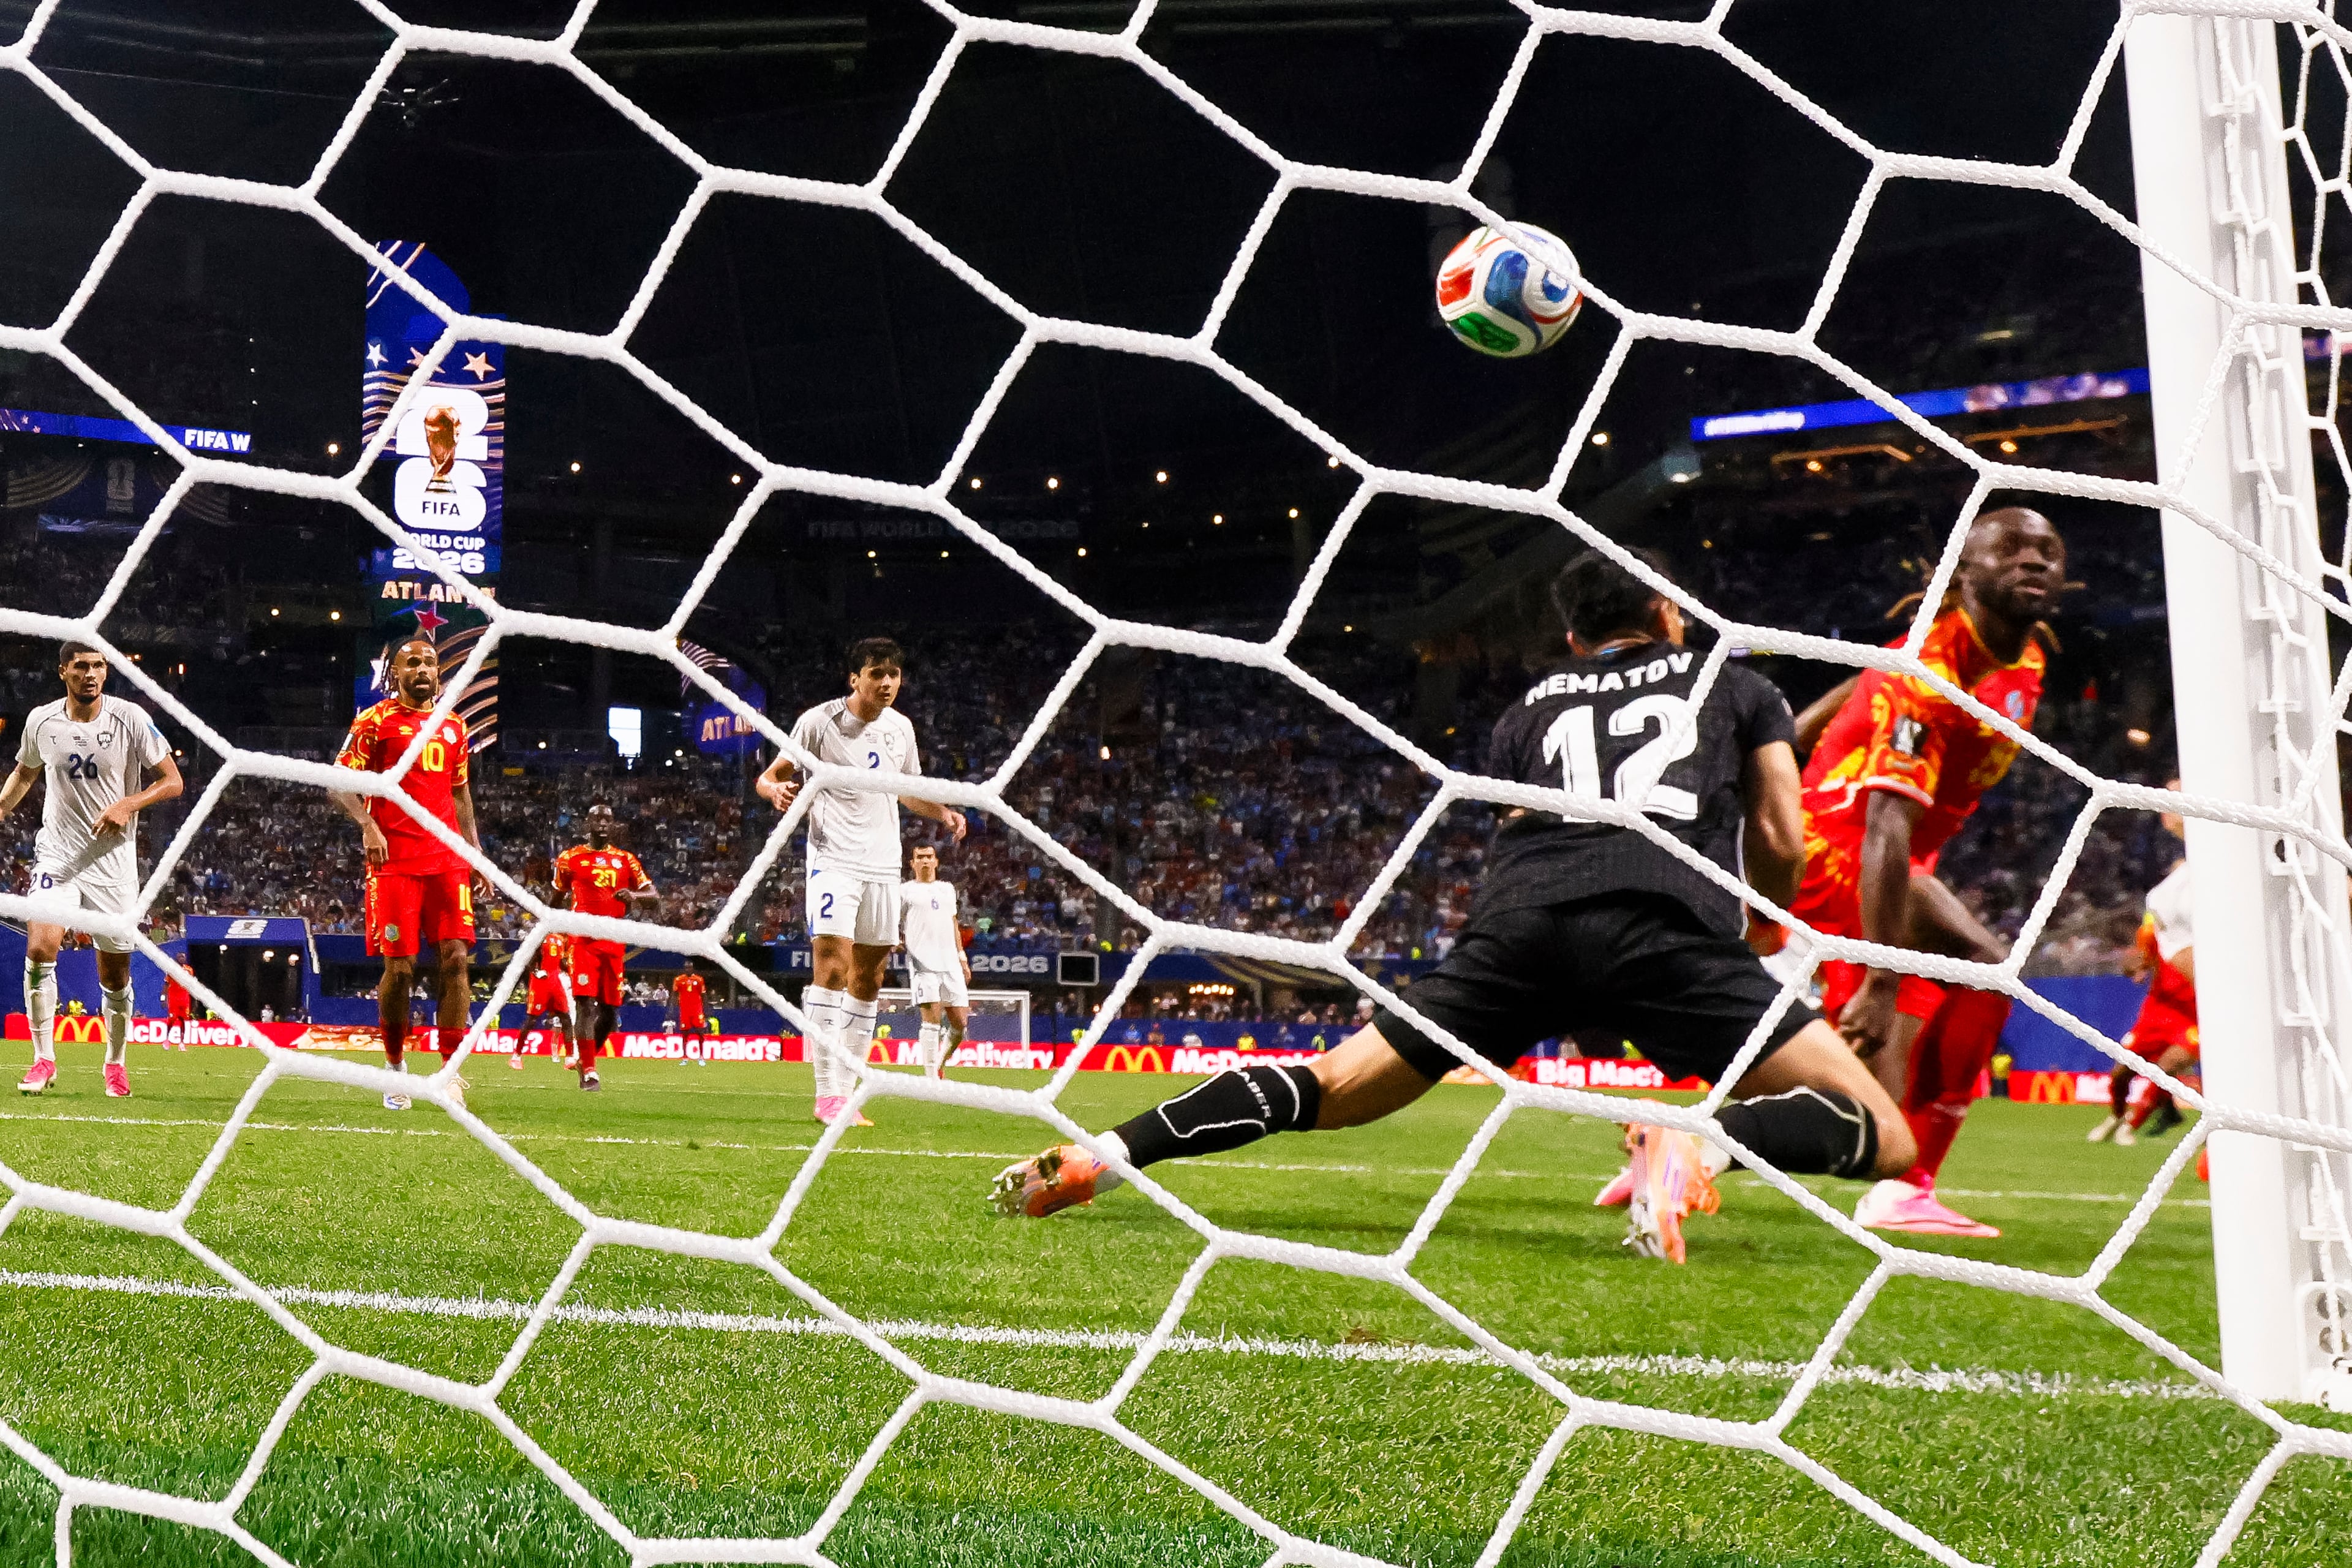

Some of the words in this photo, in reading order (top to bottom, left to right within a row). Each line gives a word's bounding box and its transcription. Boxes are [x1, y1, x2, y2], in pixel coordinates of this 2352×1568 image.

[185, 429, 230, 450] FIFA
[231, 434, 251, 451] W
[422, 501, 461, 516] FIFA
[396, 532, 452, 549] ORLD
[453, 536, 486, 551] CUP
[1525, 652, 1694, 706] NEMATOV
[69, 753, 98, 779] 26
[422, 742, 445, 772] 10
[868, 751, 880, 769] 2
[1542, 693, 1698, 823] 12
[821, 892, 834, 919] 2
[930, 897, 940, 910] 6
[971, 954, 1049, 974] 2026
[622, 1034, 782, 1061] McDonald's
[1536, 1058, 1586, 1088] Big
